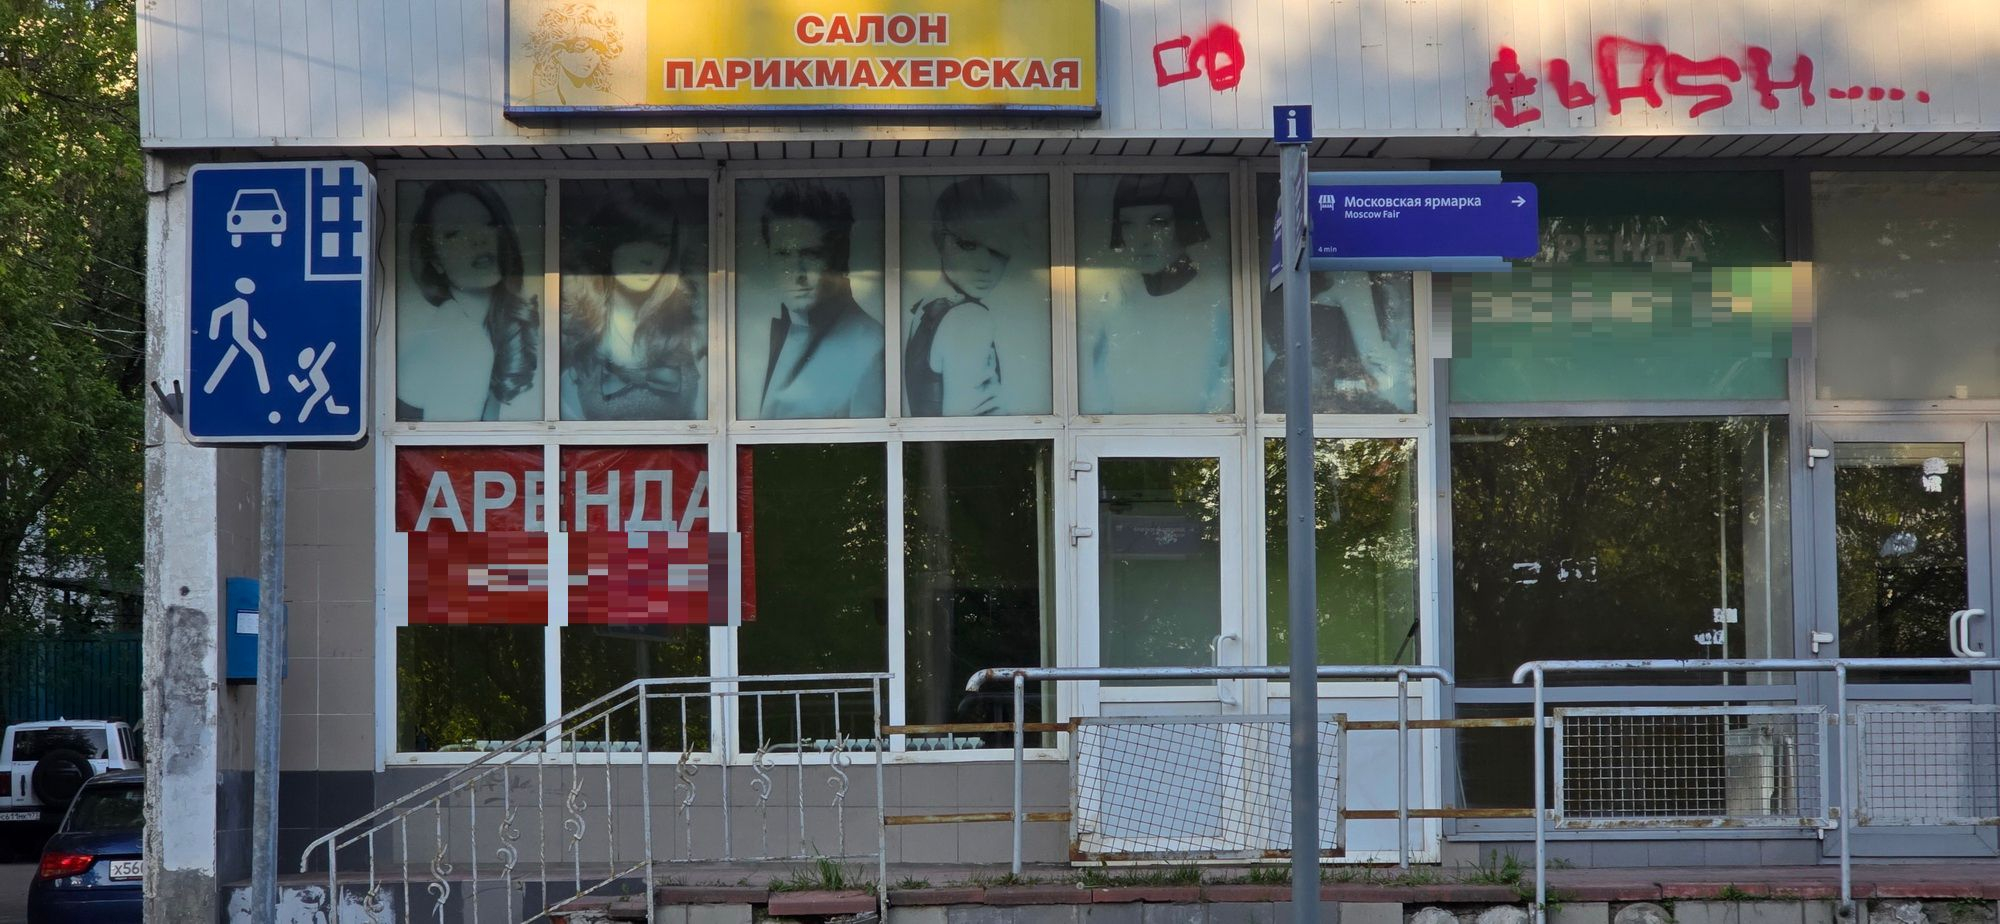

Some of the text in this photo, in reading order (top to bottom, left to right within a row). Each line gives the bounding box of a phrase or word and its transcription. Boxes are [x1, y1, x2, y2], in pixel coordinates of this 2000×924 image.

[796, 14, 948, 45] САЛОН
[665, 58, 1081, 90] ПАРИКМАХЕРСКАЯ
[1344, 196, 1482, 210] Московская ярмарка
[1344, 209, 1400, 219] Moscow Fair
